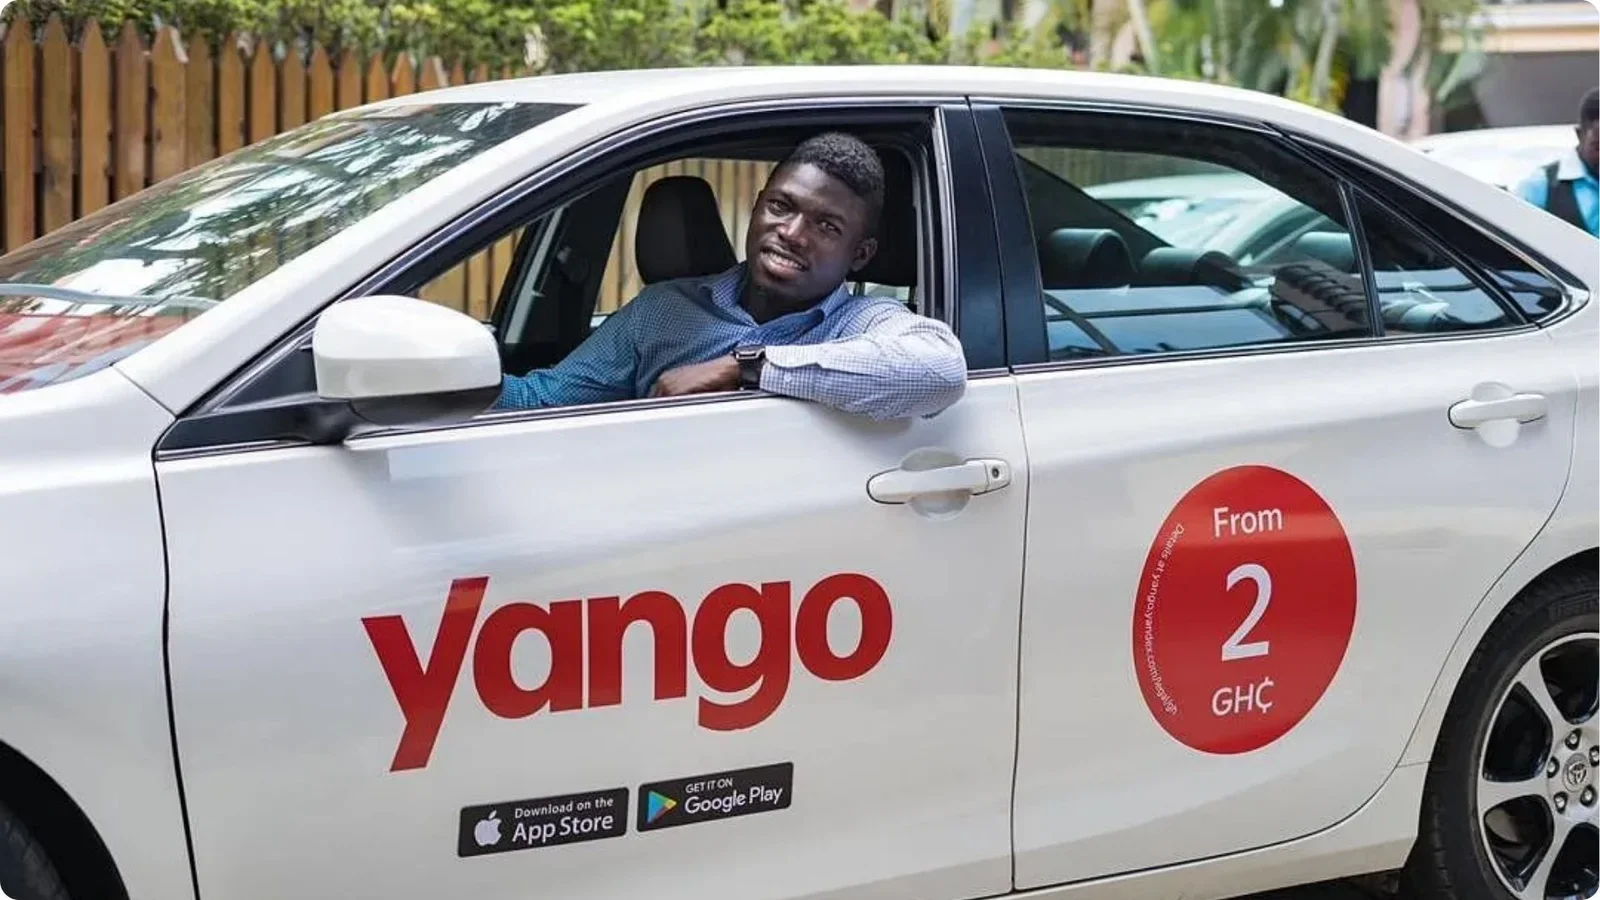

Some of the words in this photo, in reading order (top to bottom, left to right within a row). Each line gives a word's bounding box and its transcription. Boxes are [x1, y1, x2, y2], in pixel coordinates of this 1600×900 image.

[1213, 506, 1283, 538] From
[1160, 522, 1185, 560] Details
[1156, 560, 1166, 574] at
[1221, 563, 1273, 662] 2
[361, 572, 893, 773] yango
[684, 789, 747, 814] Google
[748, 785, 783, 805] Play
[685, 782, 706, 793] GET
[707, 780, 716, 790] IT
[717, 777, 733, 789] ON
[514, 801, 574, 819] Download
[576, 801, 592, 811] on
[594, 797, 614, 809] the
[511, 822, 557, 845] App
[558, 815, 614, 836] Store
